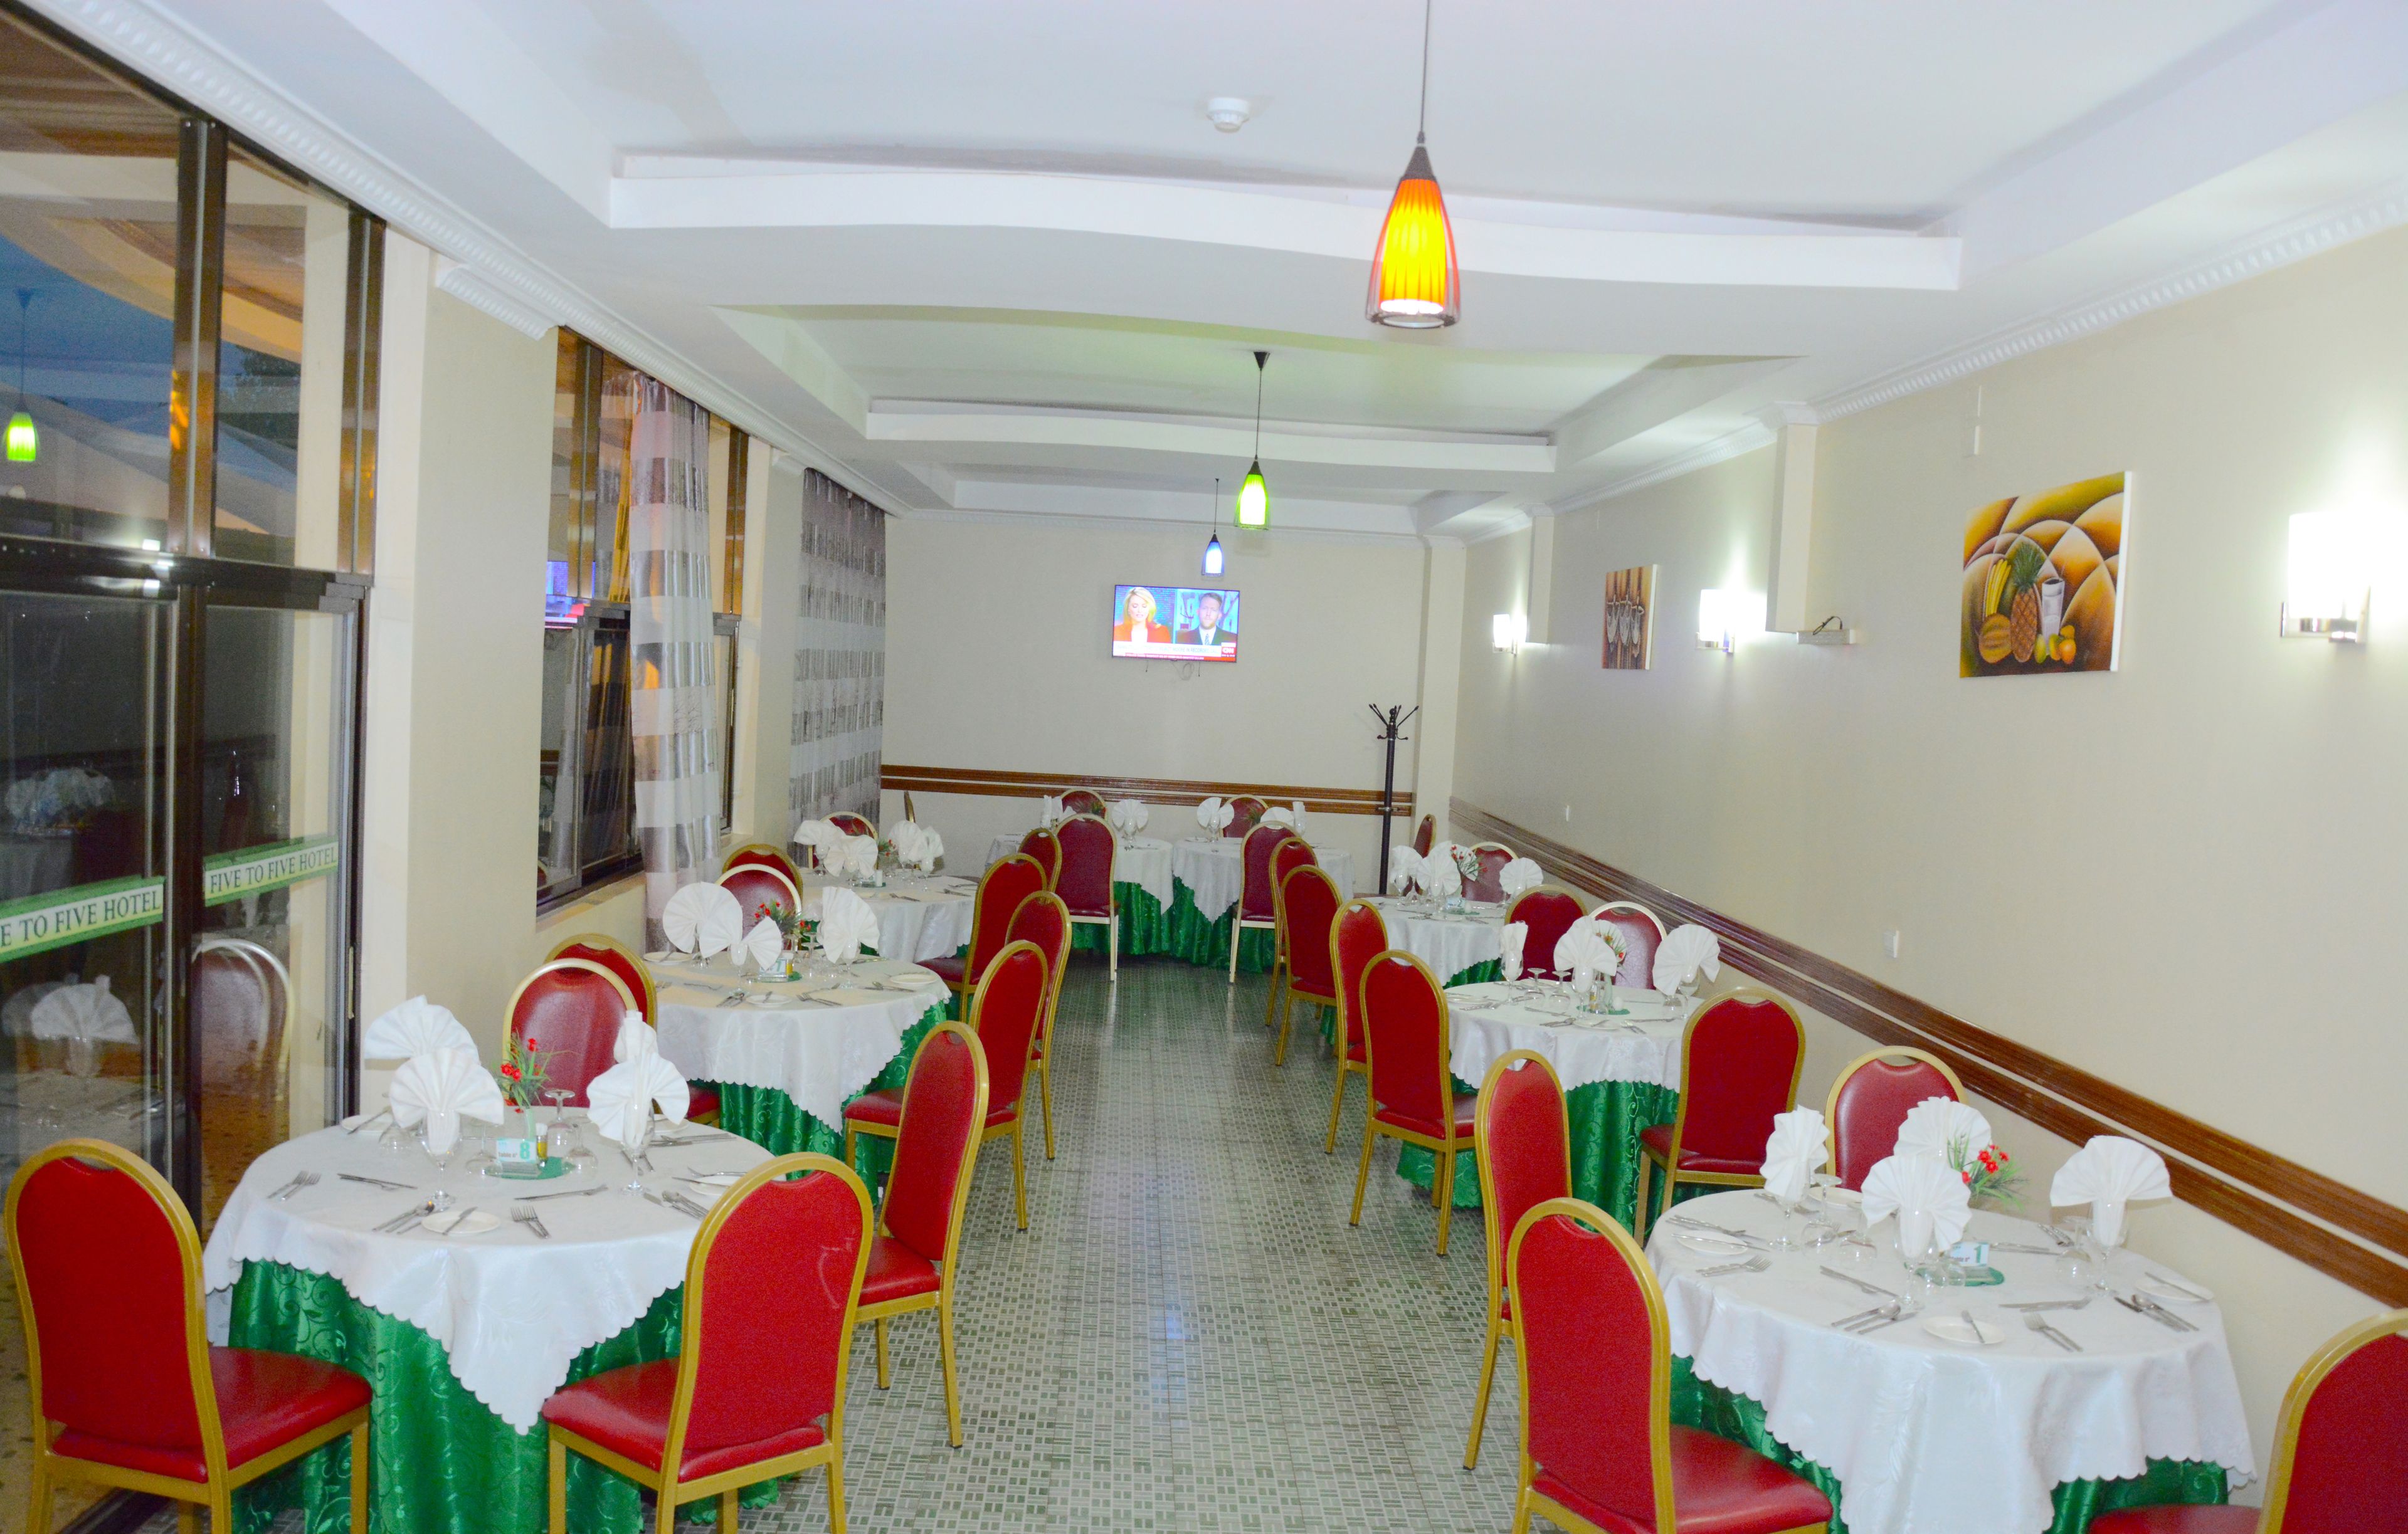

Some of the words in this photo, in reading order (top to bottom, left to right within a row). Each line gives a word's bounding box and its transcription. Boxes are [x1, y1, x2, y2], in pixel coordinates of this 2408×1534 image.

[210, 869, 241, 893] FIVE
[246, 864, 264, 885] TO
[268, 856, 295, 880] FIVE
[299, 847, 337, 871] HOTEL
[1457, 899, 1462, 908] 2
[19, 915, 48, 941] TO
[55, 903, 97, 933] FIVE
[103, 891, 161, 921] HOTEL
[520, 1142, 531, 1160] 8
[1974, 1245, 1982, 1263] 1
